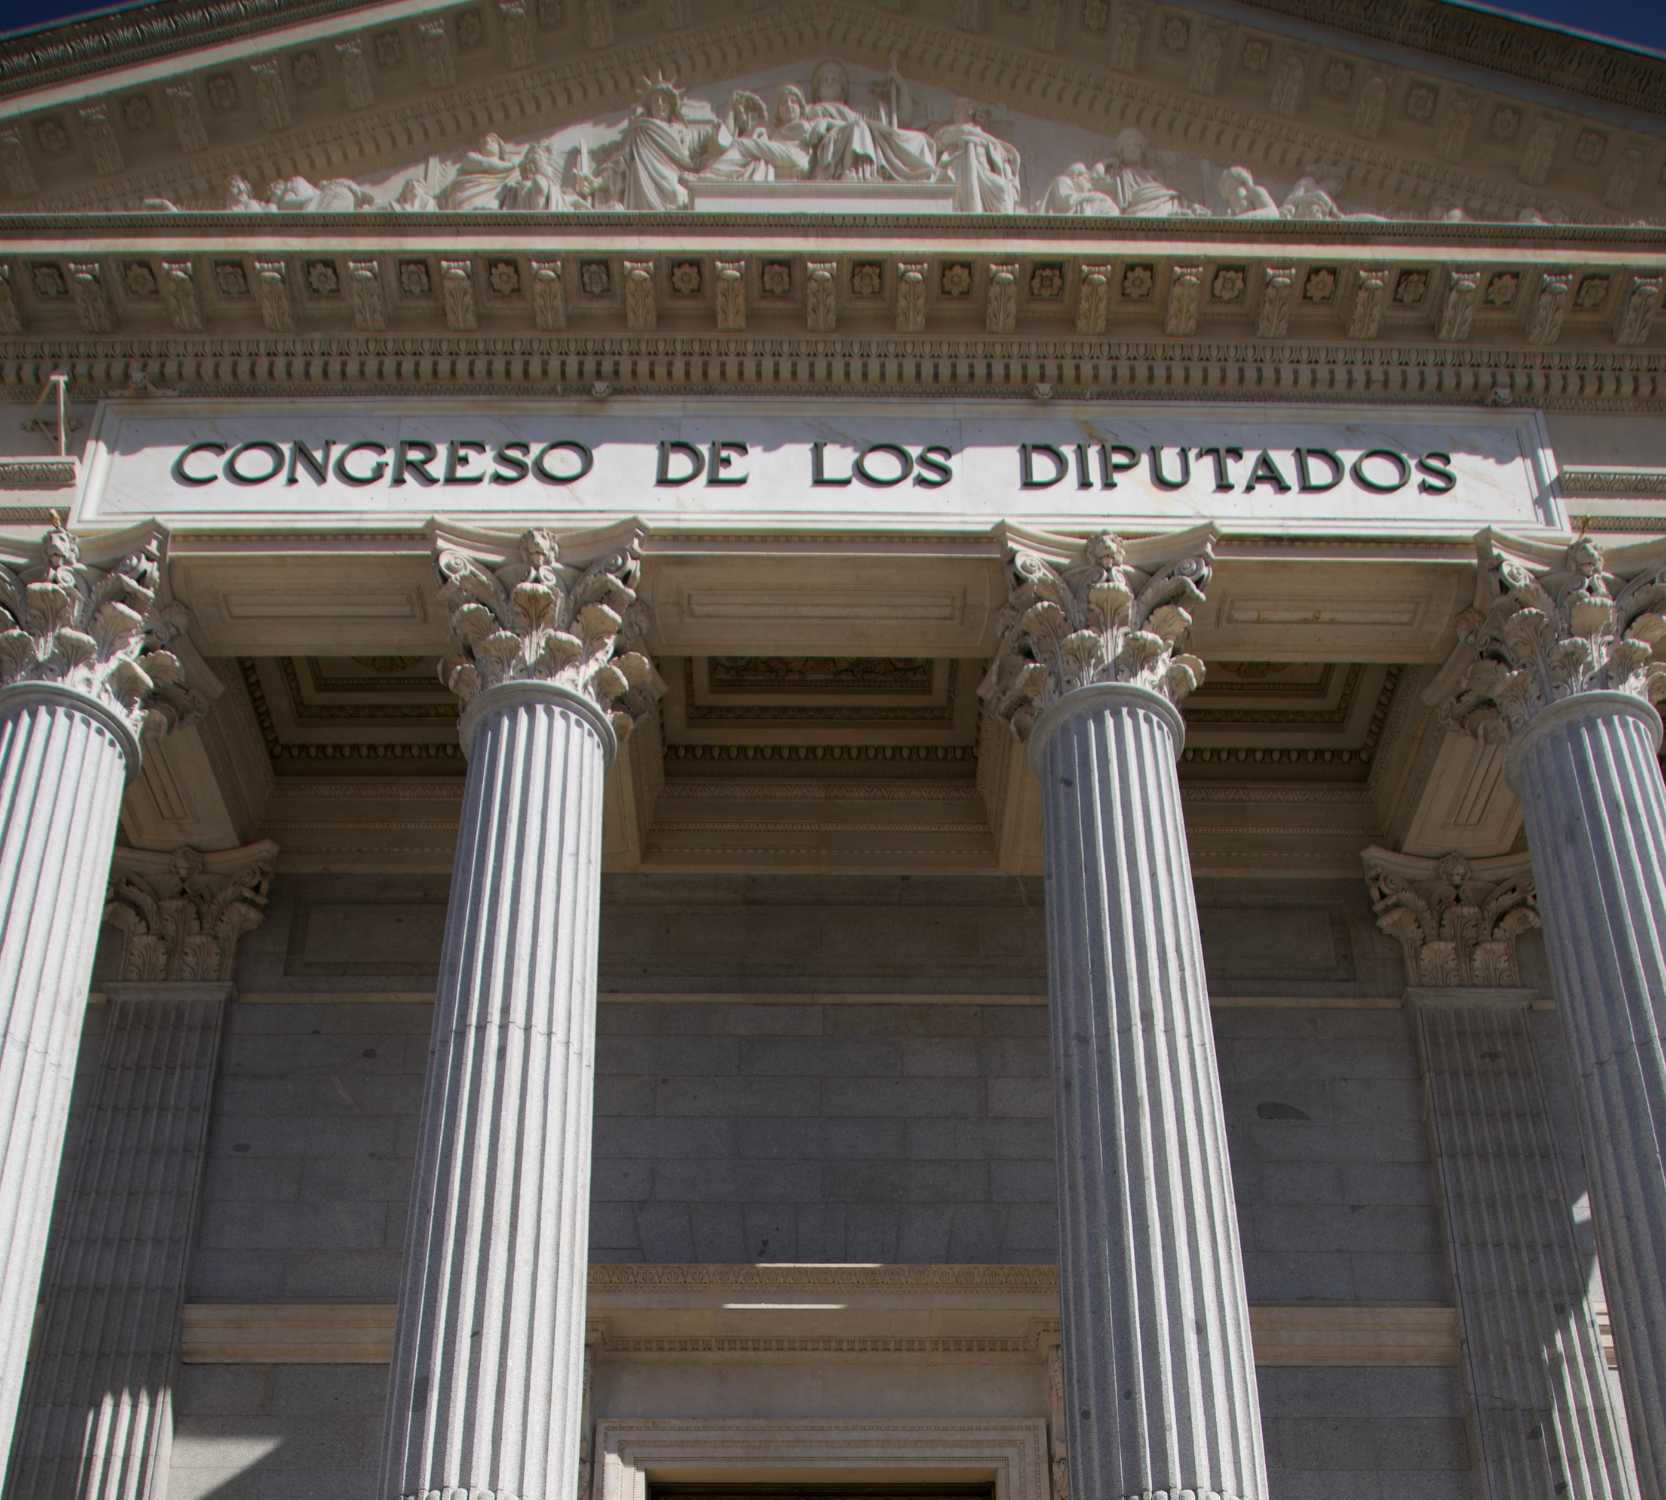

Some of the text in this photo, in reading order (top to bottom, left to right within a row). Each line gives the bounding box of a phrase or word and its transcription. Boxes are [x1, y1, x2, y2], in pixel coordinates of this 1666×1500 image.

[171, 440, 1458, 494] CONGRESO DE LOS DIPUTADOS
